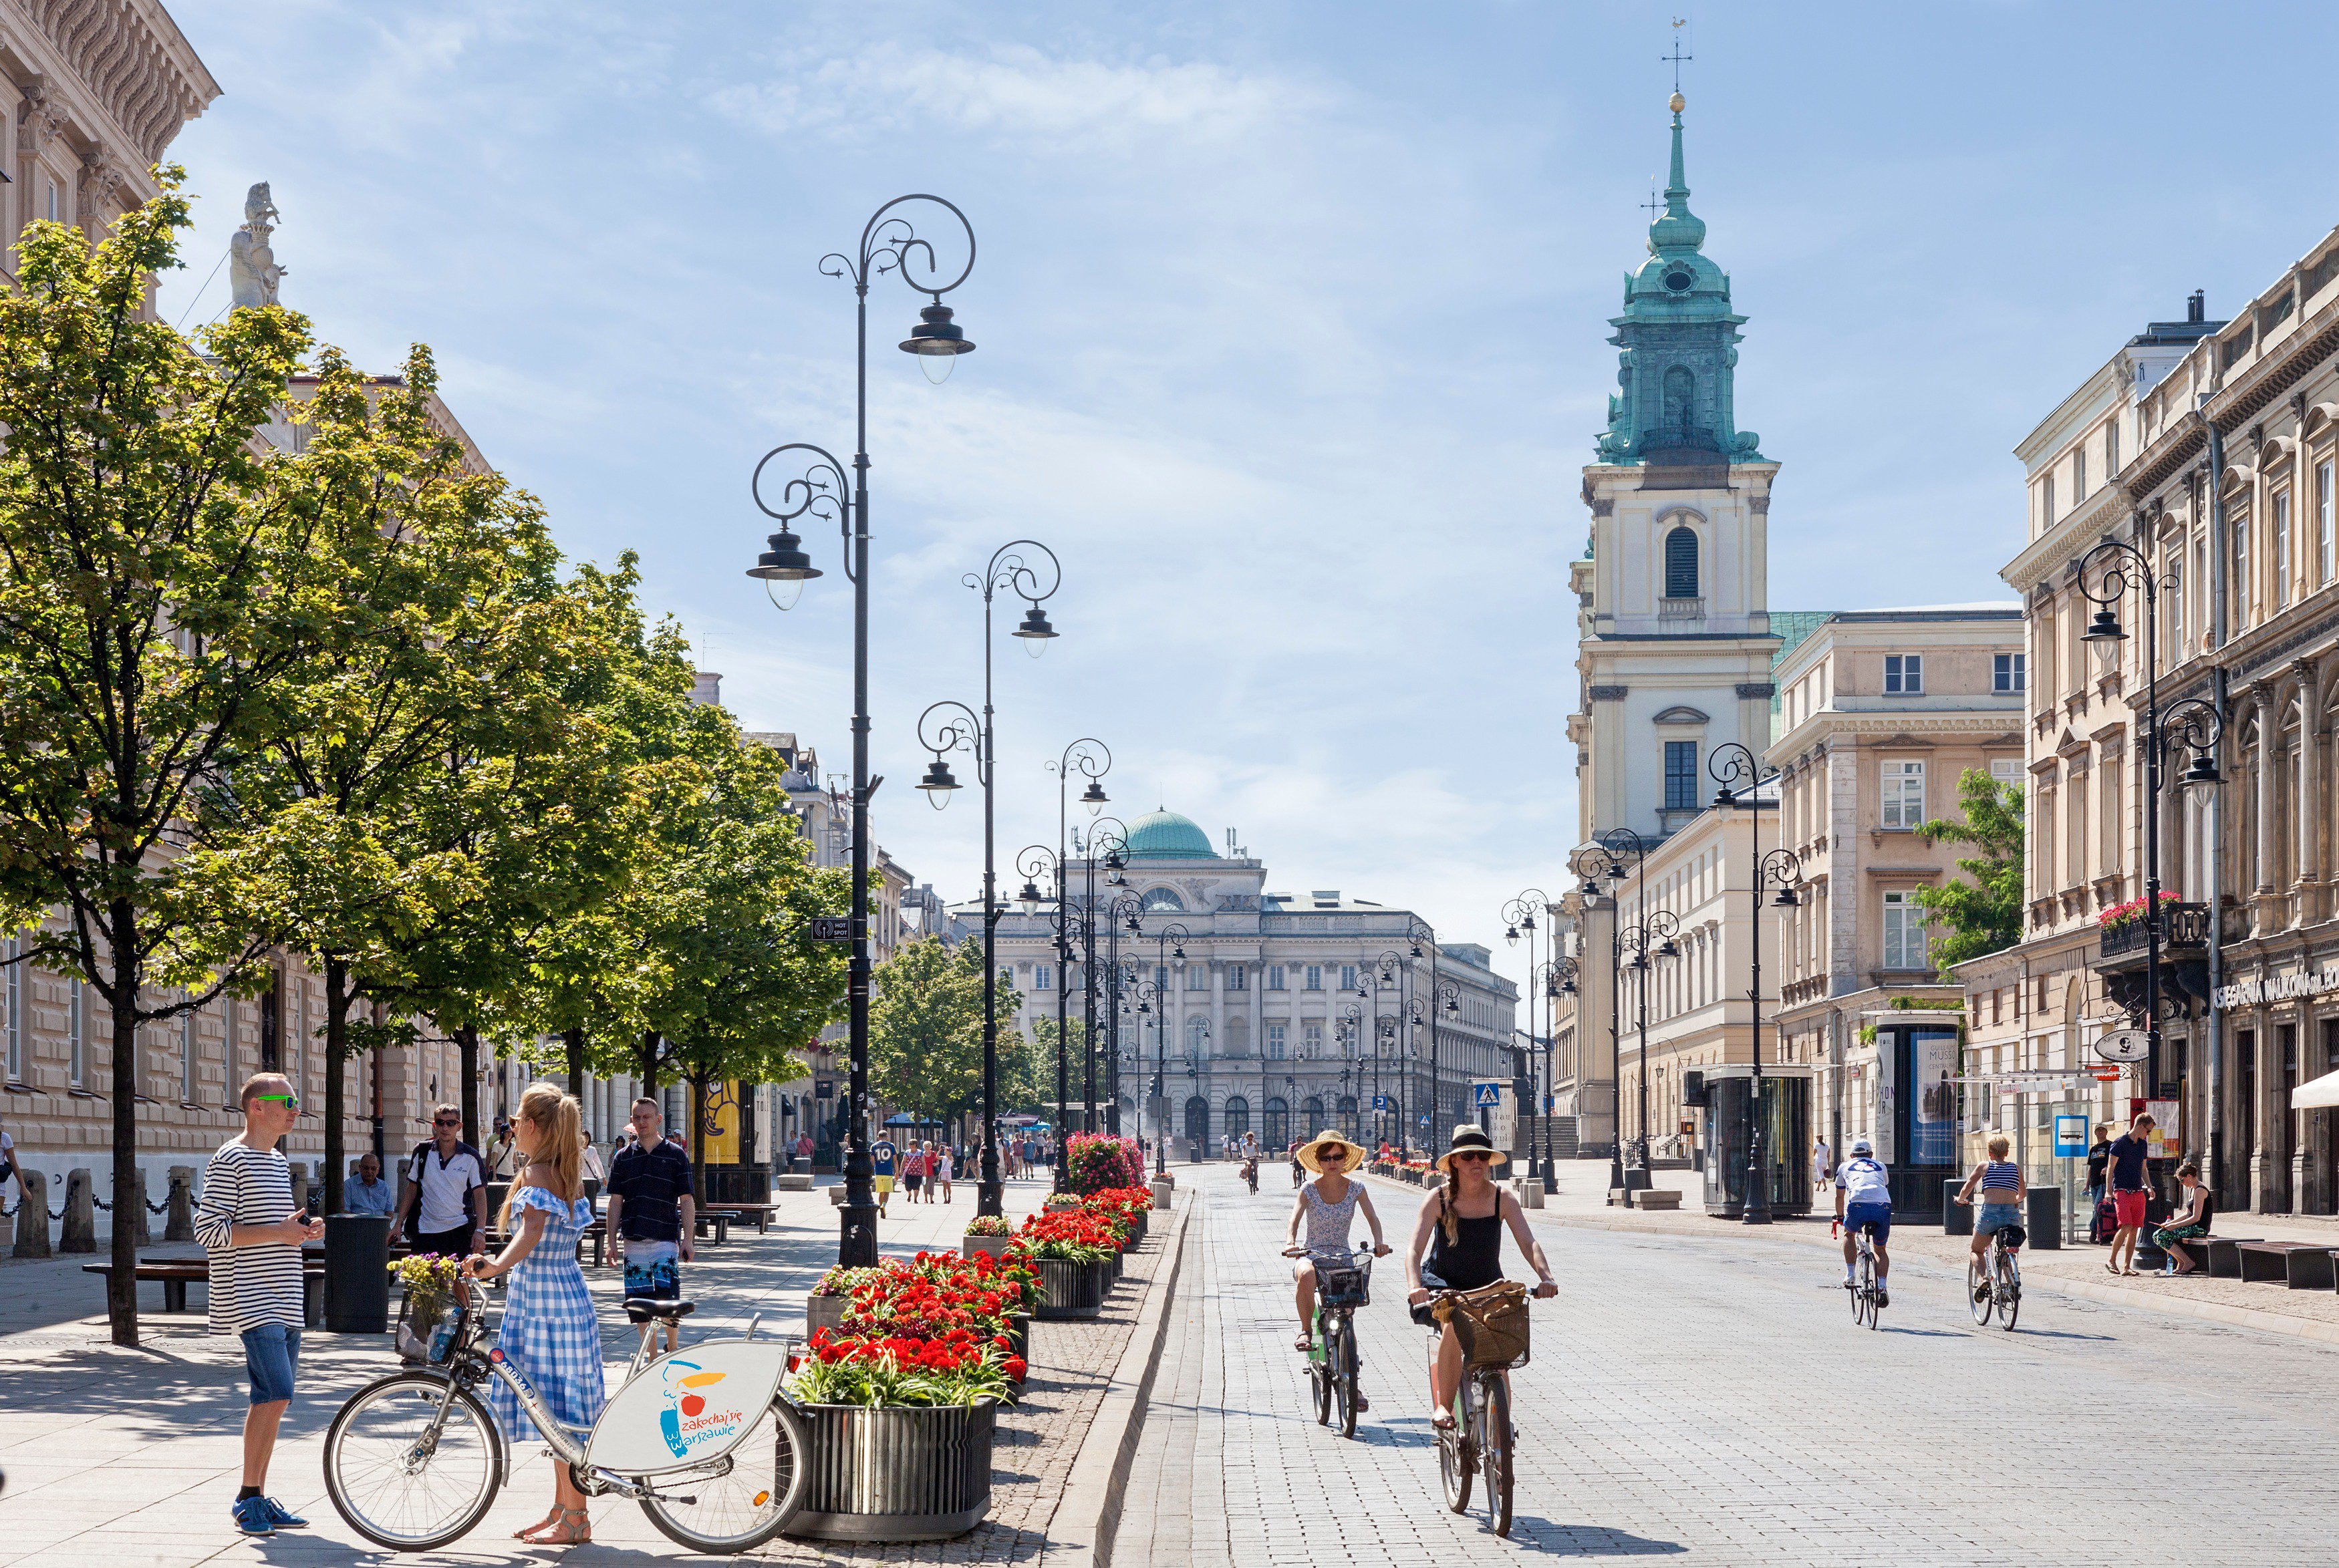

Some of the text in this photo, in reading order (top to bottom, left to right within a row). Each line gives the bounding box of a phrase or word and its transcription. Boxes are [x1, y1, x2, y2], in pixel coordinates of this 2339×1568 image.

[2213, 981, 2263, 1011] KSIĘGARNIA
[2265, 972, 2310, 1002] NAUKOWA
[2102, 1032, 2131, 1044] Kawiarnia
[1929, 1050, 1955, 1060] MUSSO
[875, 1148, 891, 1160] 10
[501, 1362, 527, 1390] 68036
[539, 1410, 551, 1423] CITY
[551, 1424, 576, 1450] SECURITY
[682, 1410, 742, 1431] zakochaj się
